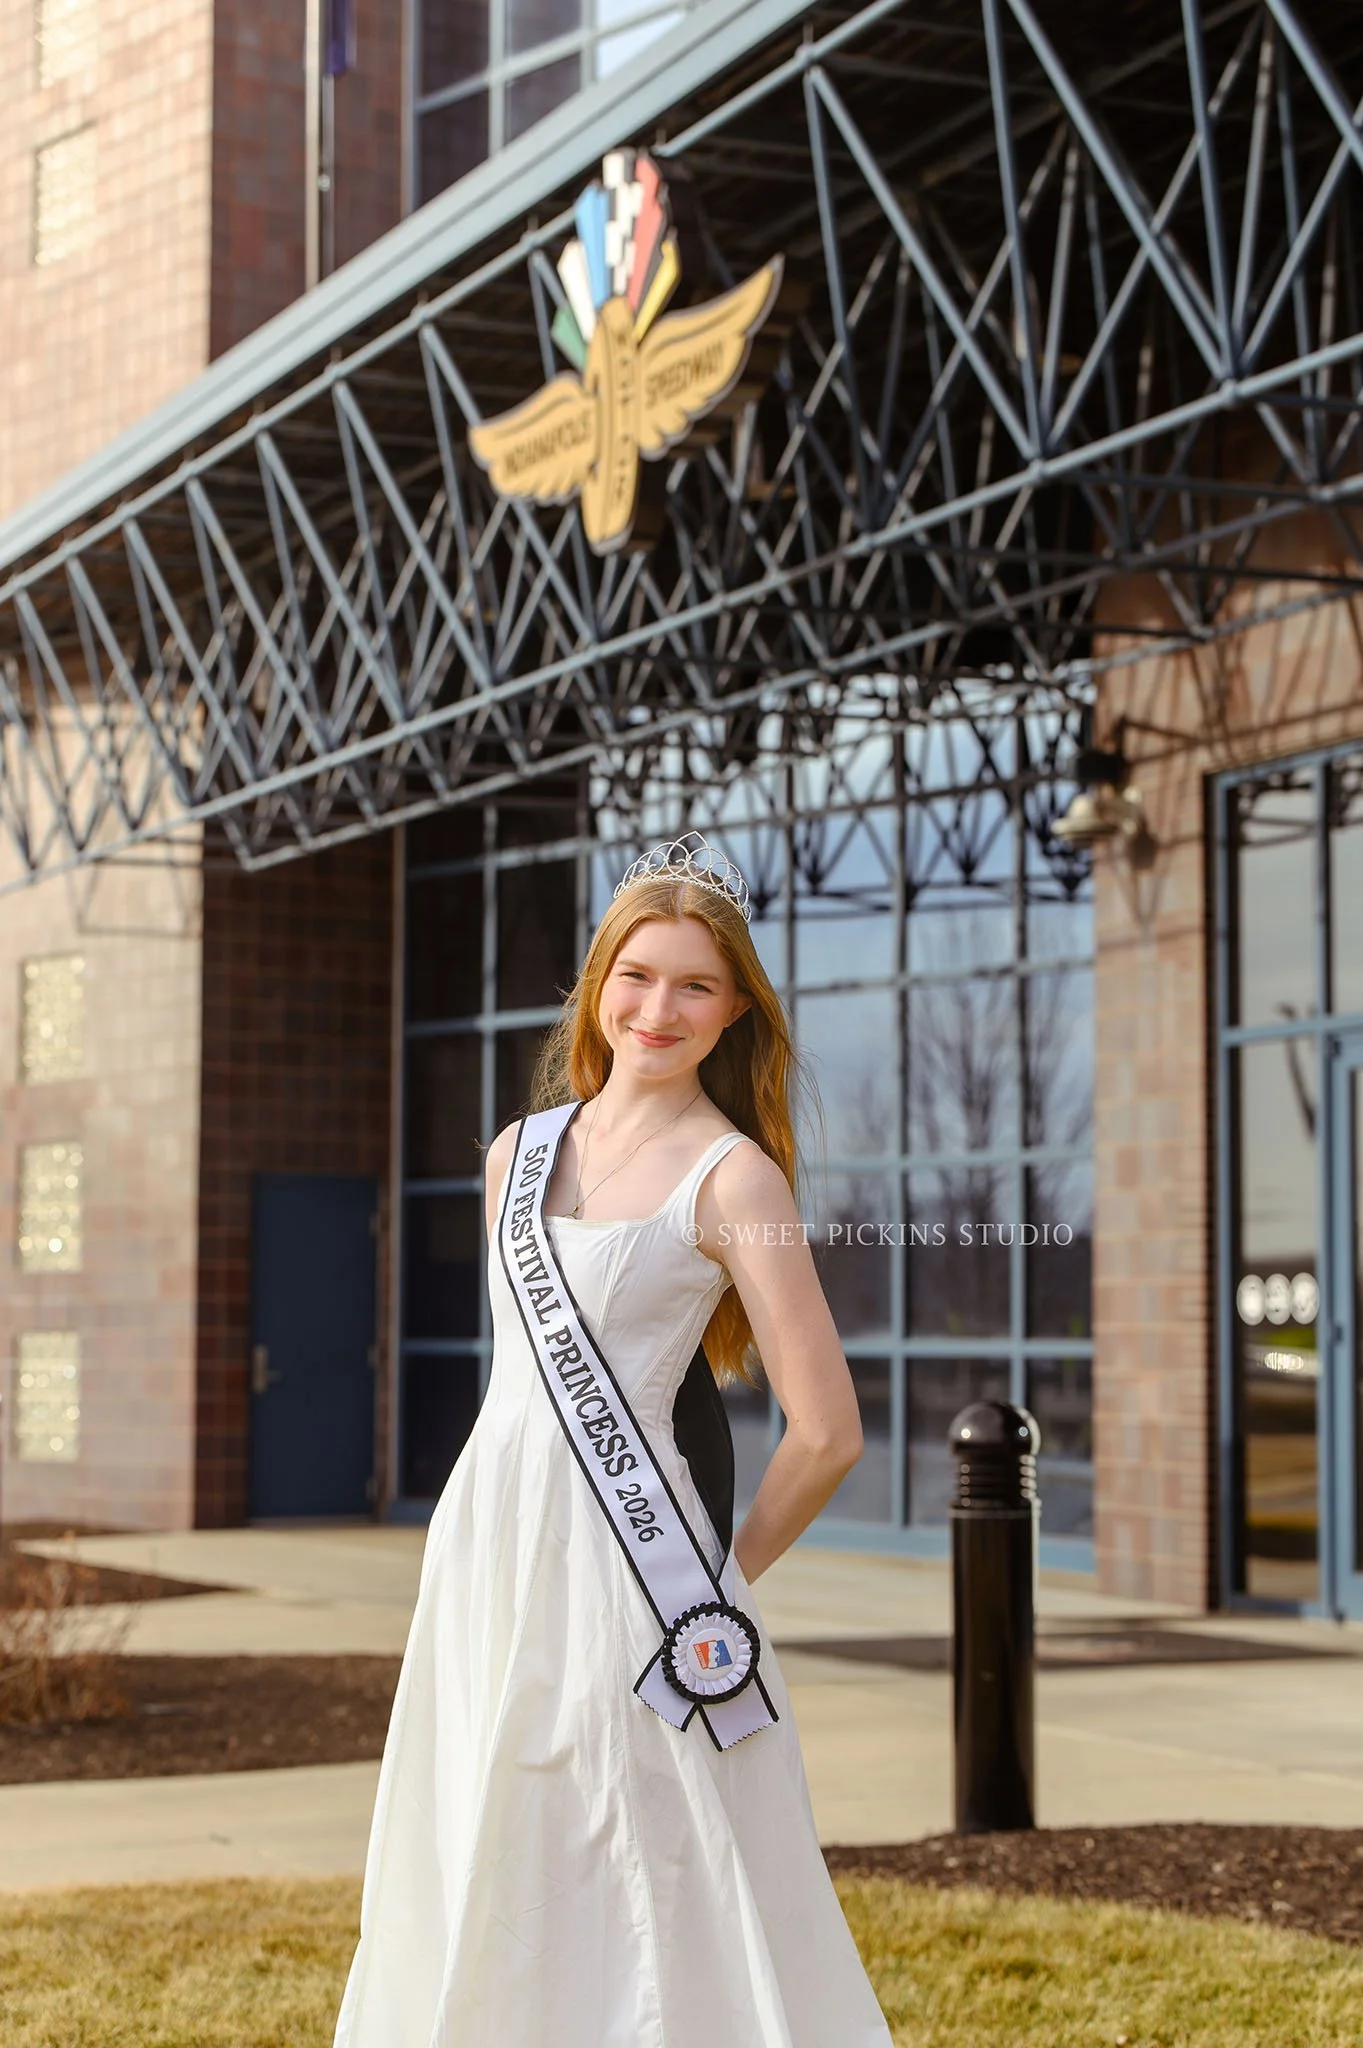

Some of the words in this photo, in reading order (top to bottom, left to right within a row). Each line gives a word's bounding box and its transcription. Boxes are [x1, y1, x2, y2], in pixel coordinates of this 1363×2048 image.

[519, 1142, 549, 1189] 500
[511, 1187, 562, 1326] FESTIVAL
[544, 1324, 639, 1478] PRINCESS
[615, 1482, 665, 1543] 2026
